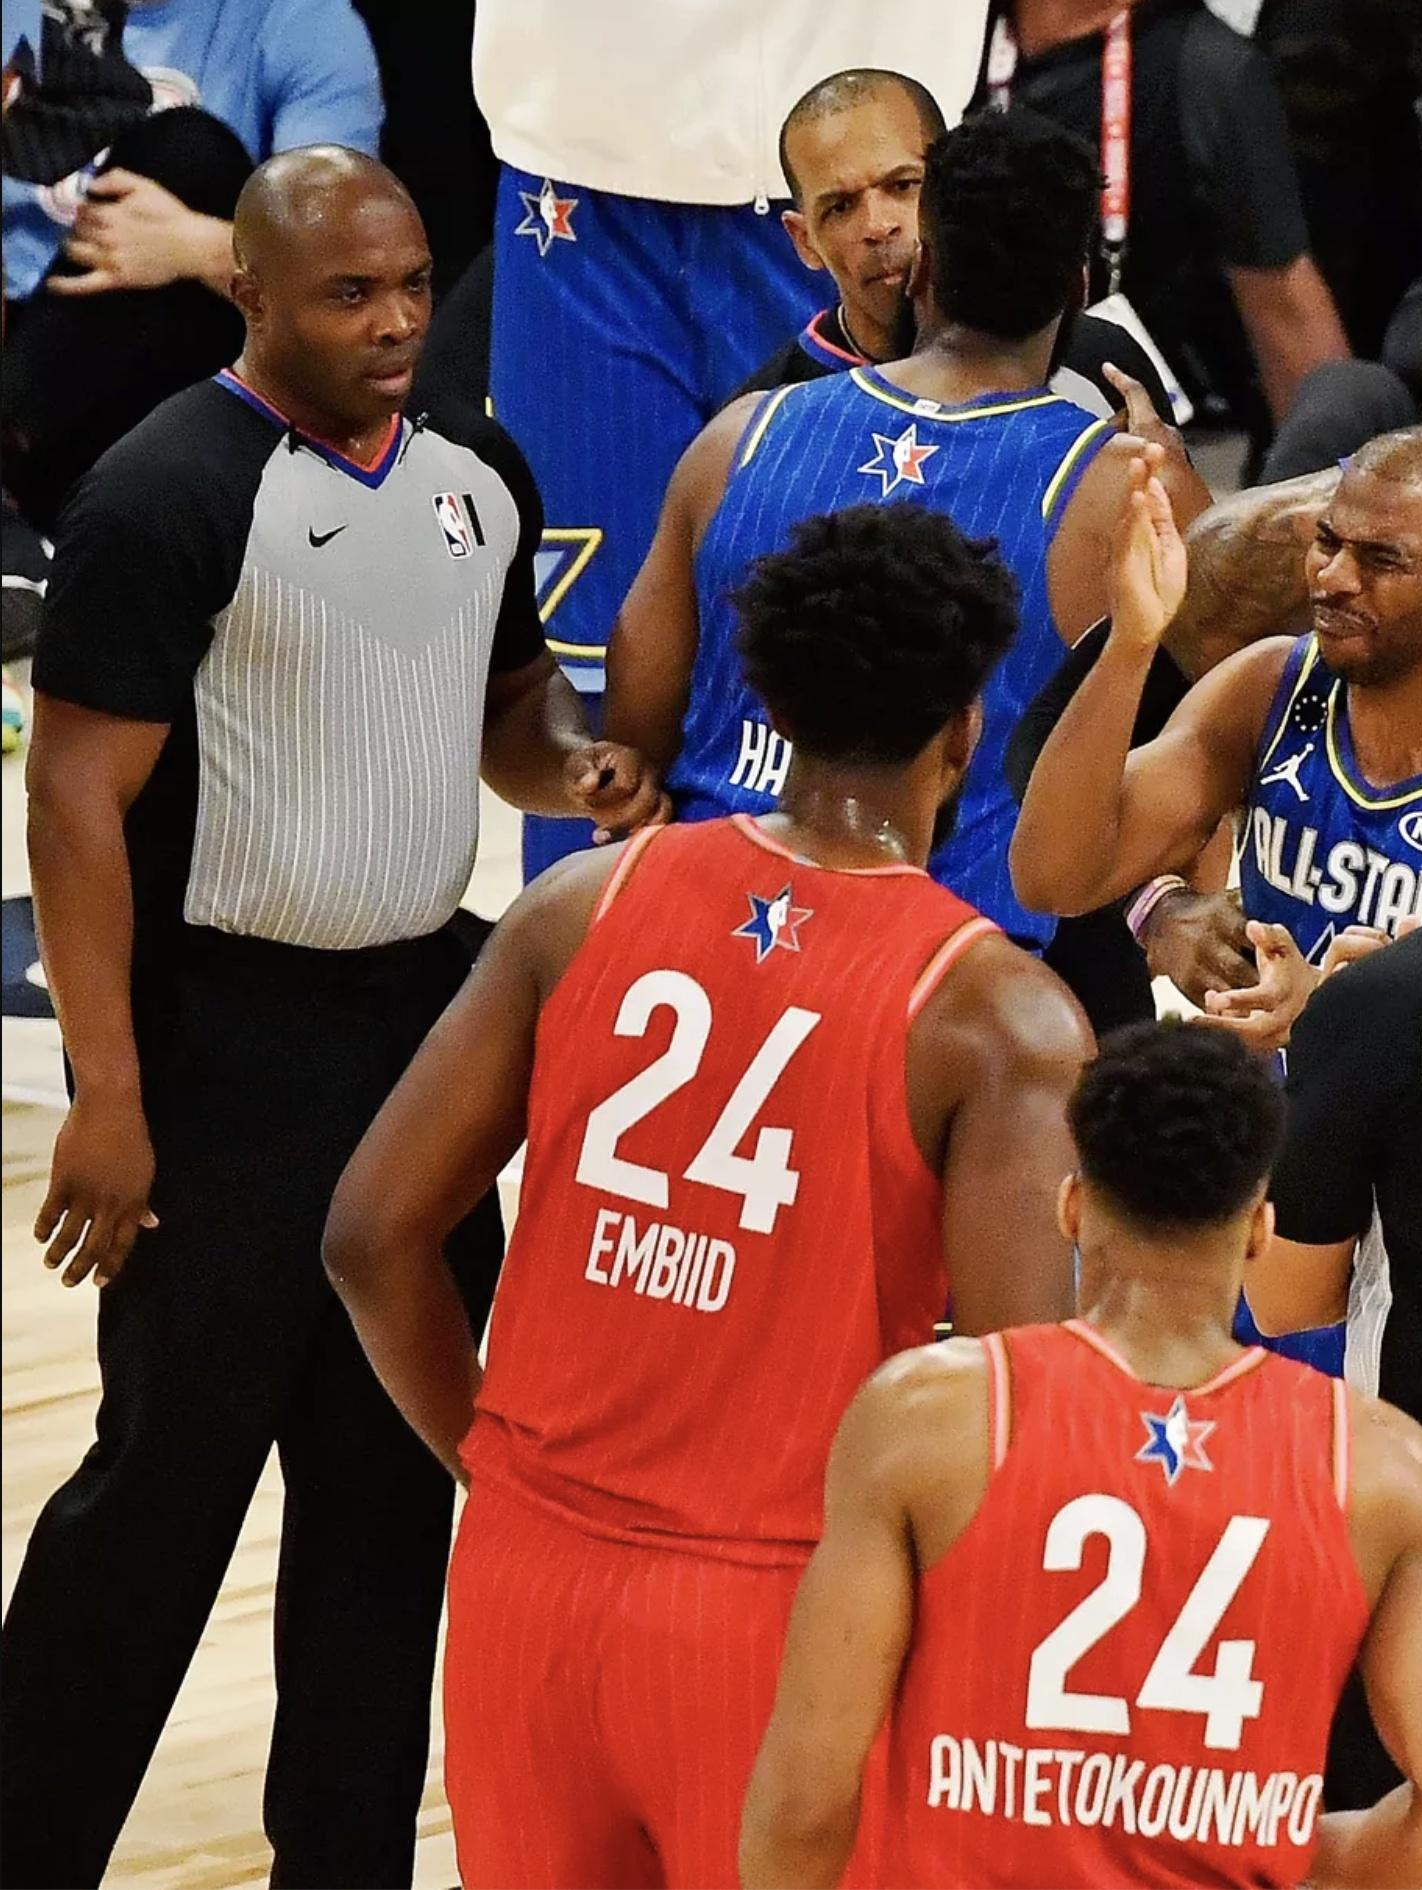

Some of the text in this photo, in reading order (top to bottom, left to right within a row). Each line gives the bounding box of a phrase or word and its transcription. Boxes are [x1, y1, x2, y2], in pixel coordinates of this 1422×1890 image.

[575, 968, 822, 1236] 24
[584, 1207, 737, 1314] EMBIID
[1025, 1492, 1272, 1752] 24
[926, 1733, 1324, 1848] ANTETOKOUNMPO
